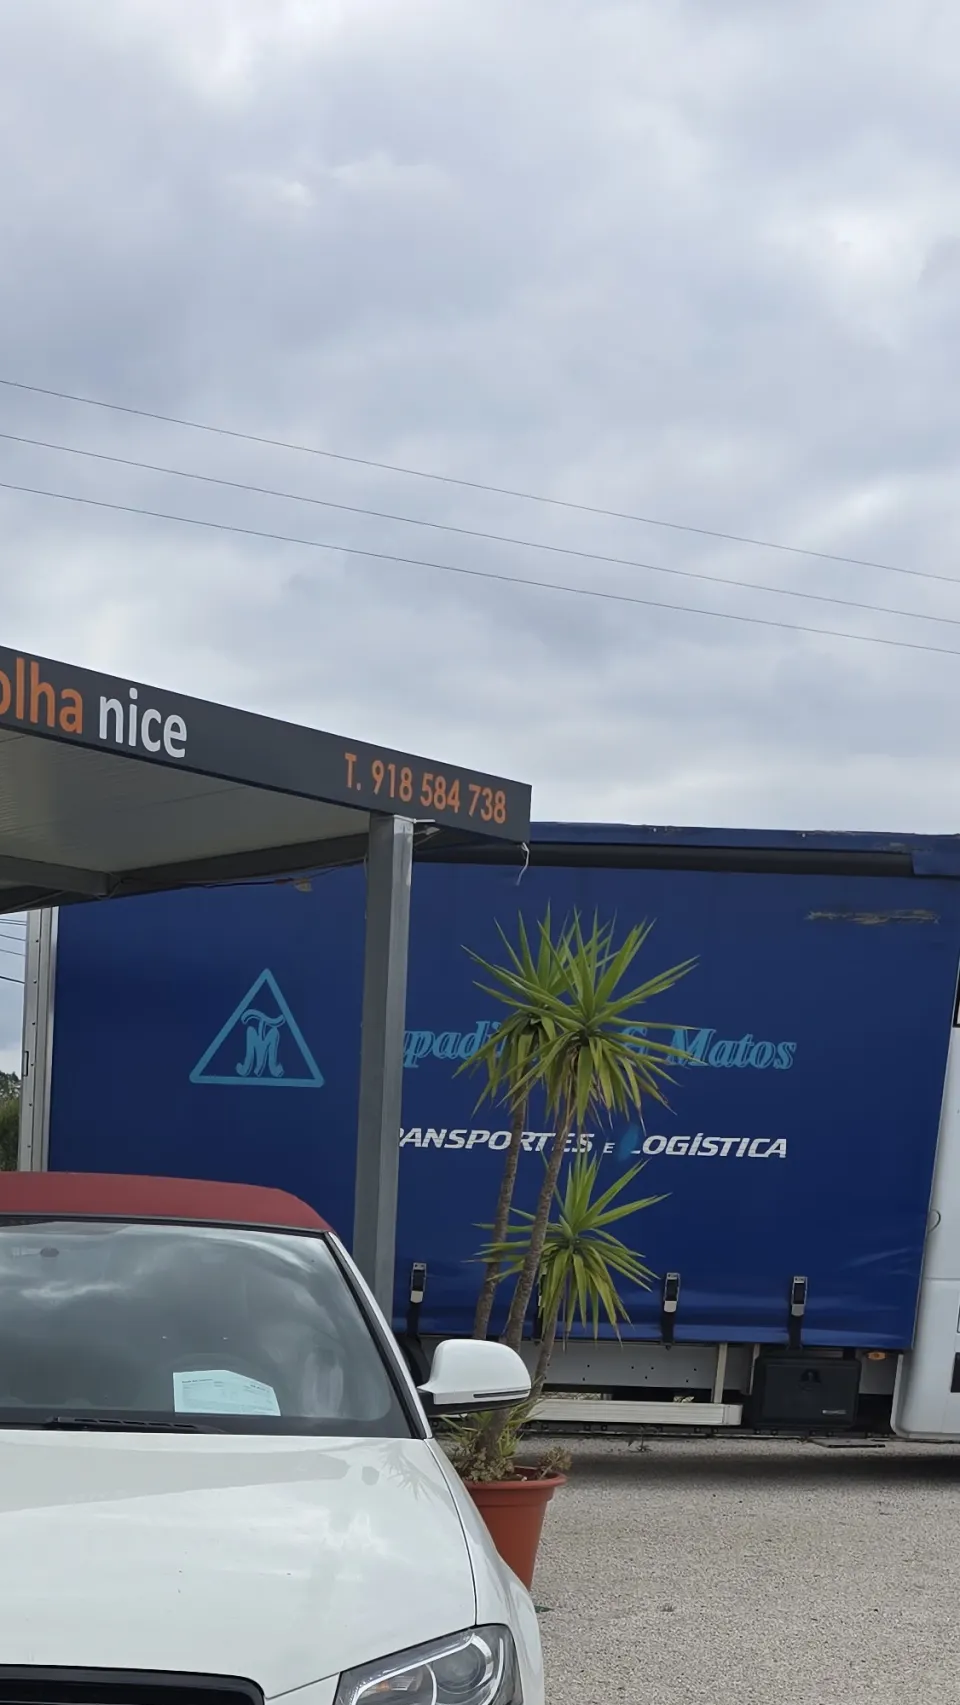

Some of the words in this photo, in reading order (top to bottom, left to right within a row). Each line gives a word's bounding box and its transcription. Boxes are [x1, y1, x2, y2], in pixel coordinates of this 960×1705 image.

[99, 687, 188, 758] nice
[345, 753, 361, 791] T.
[372, 760, 413, 802] 918
[420, 772, 460, 813] 584
[469, 784, 506, 824] 738
[666, 1027, 797, 1070] Matos
[603, 1142, 616, 1154] E
